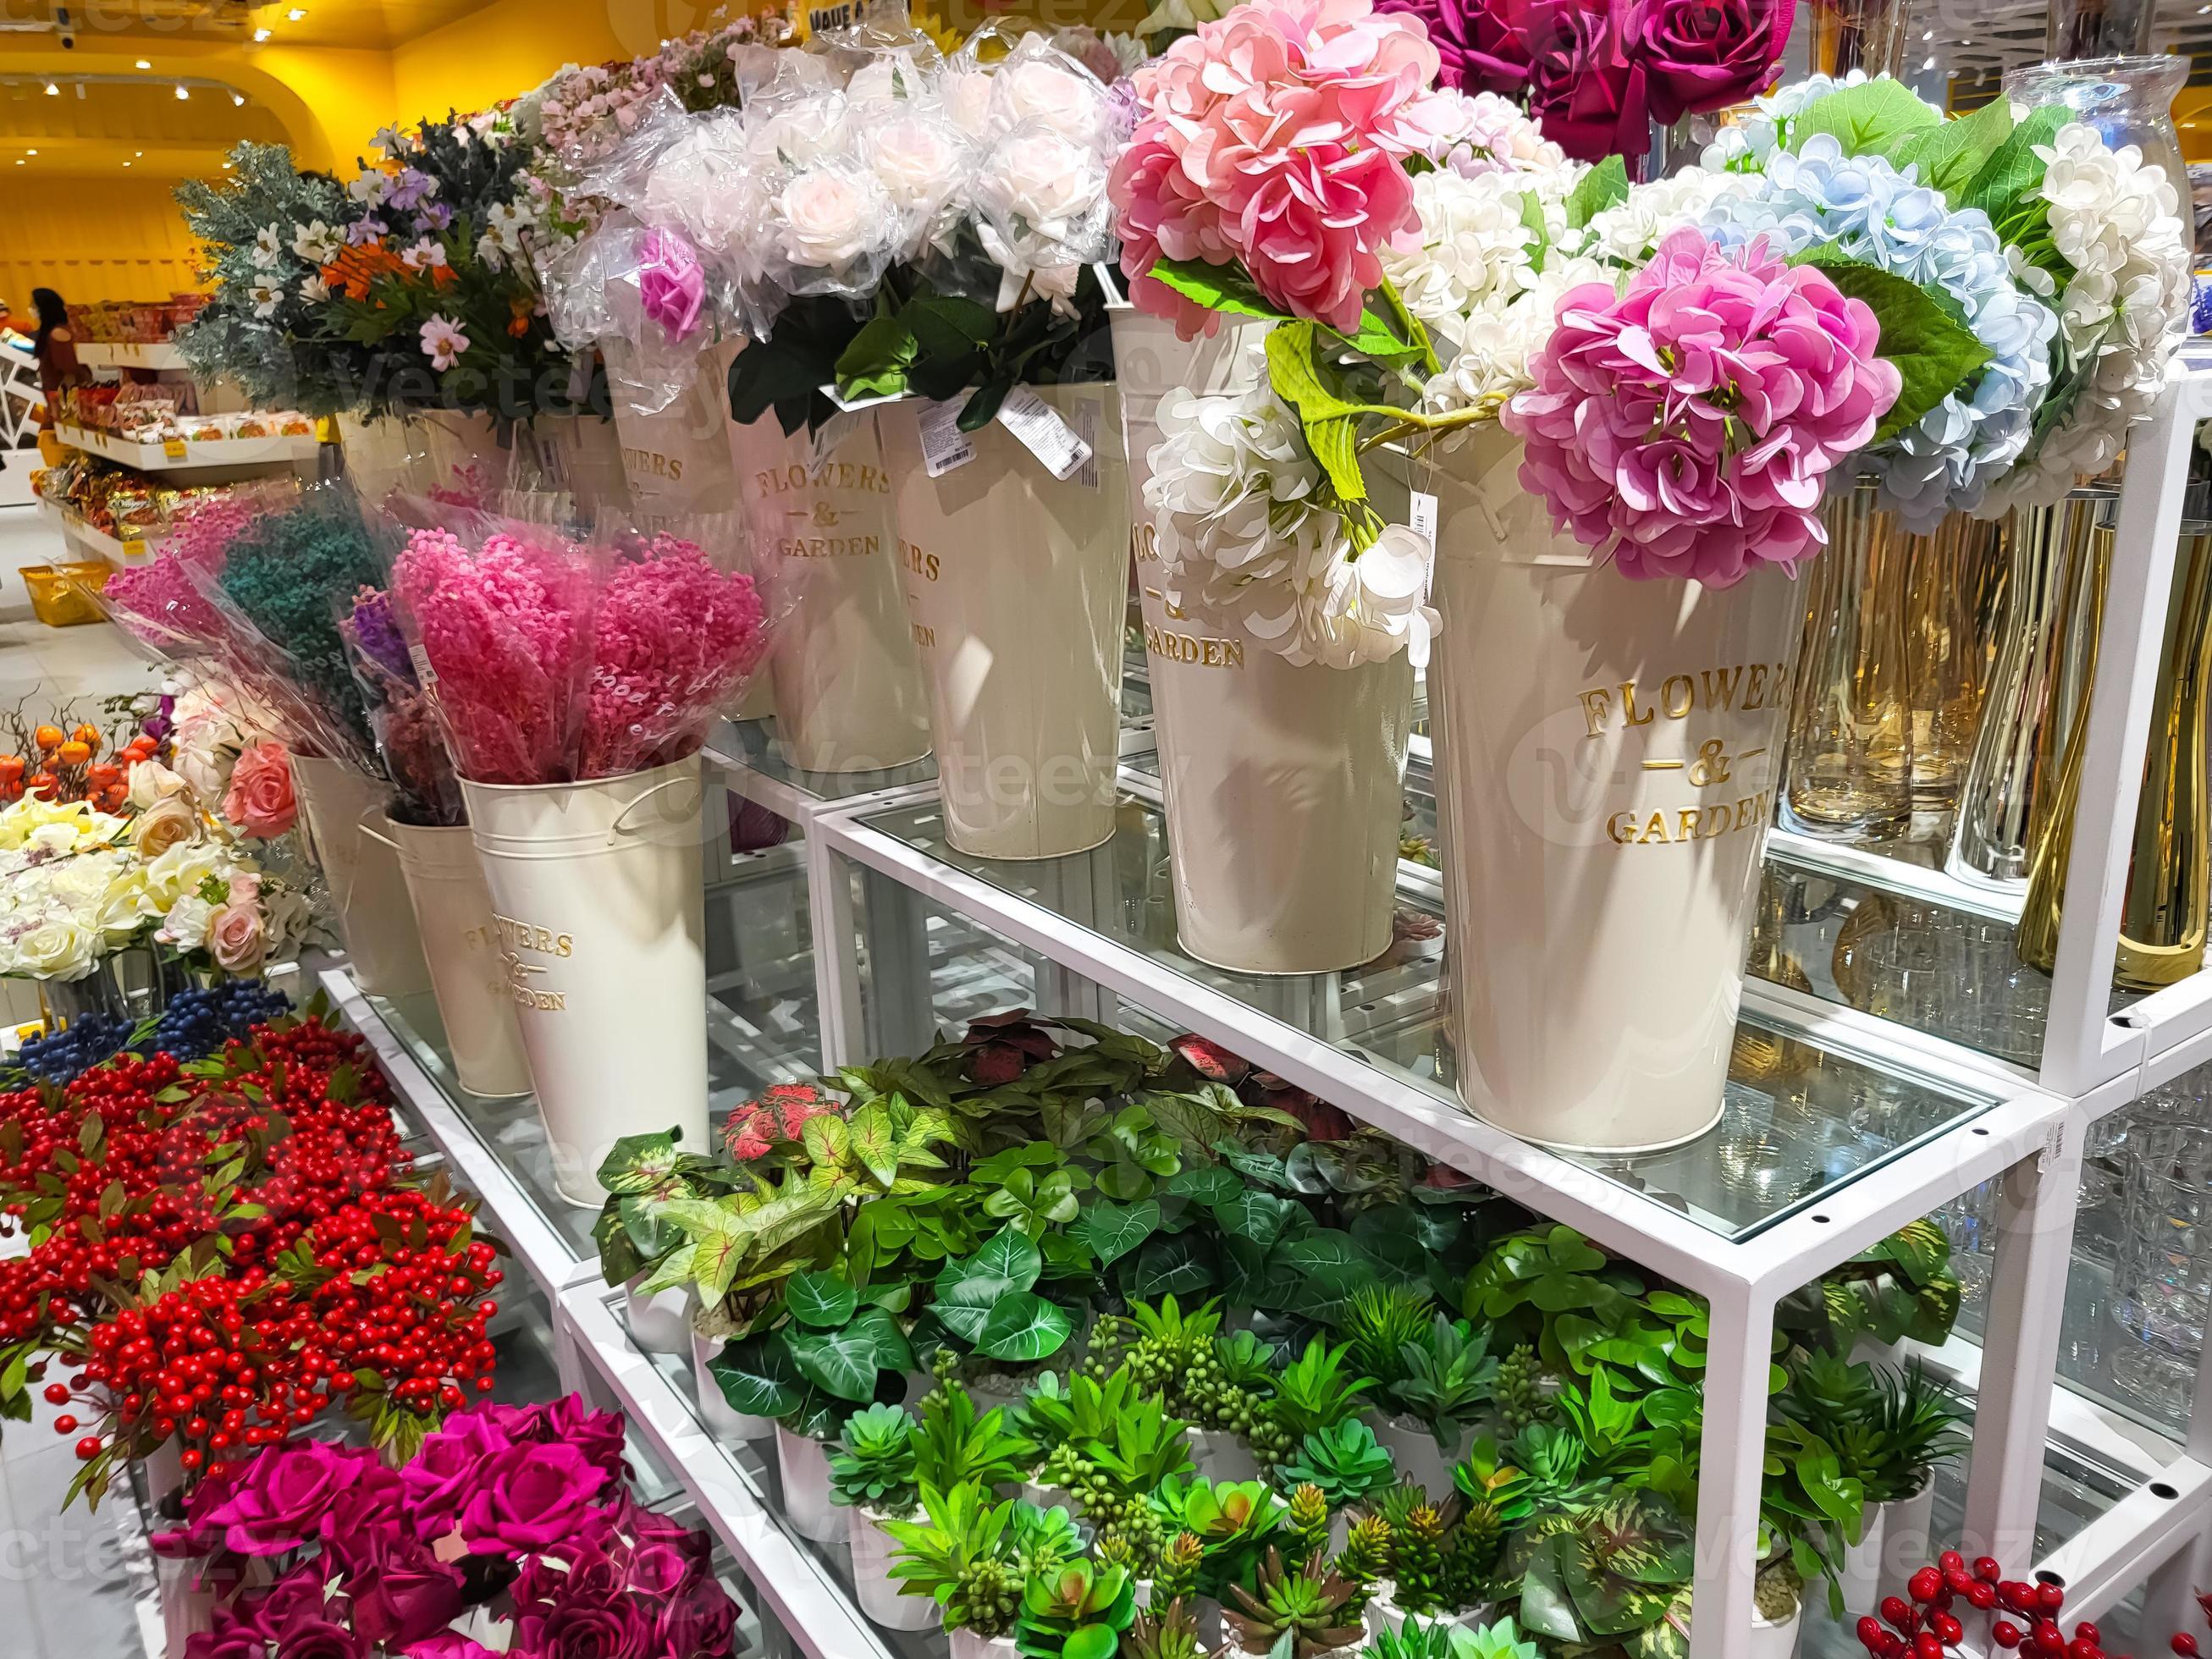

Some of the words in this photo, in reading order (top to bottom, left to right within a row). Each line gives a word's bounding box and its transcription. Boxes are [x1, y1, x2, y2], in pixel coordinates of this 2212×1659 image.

[813, 501, 839, 527] &
[778, 535, 880, 558] GARDEN
[1688, 739, 1730, 787] &
[1605, 790, 1770, 846] GARDEN
